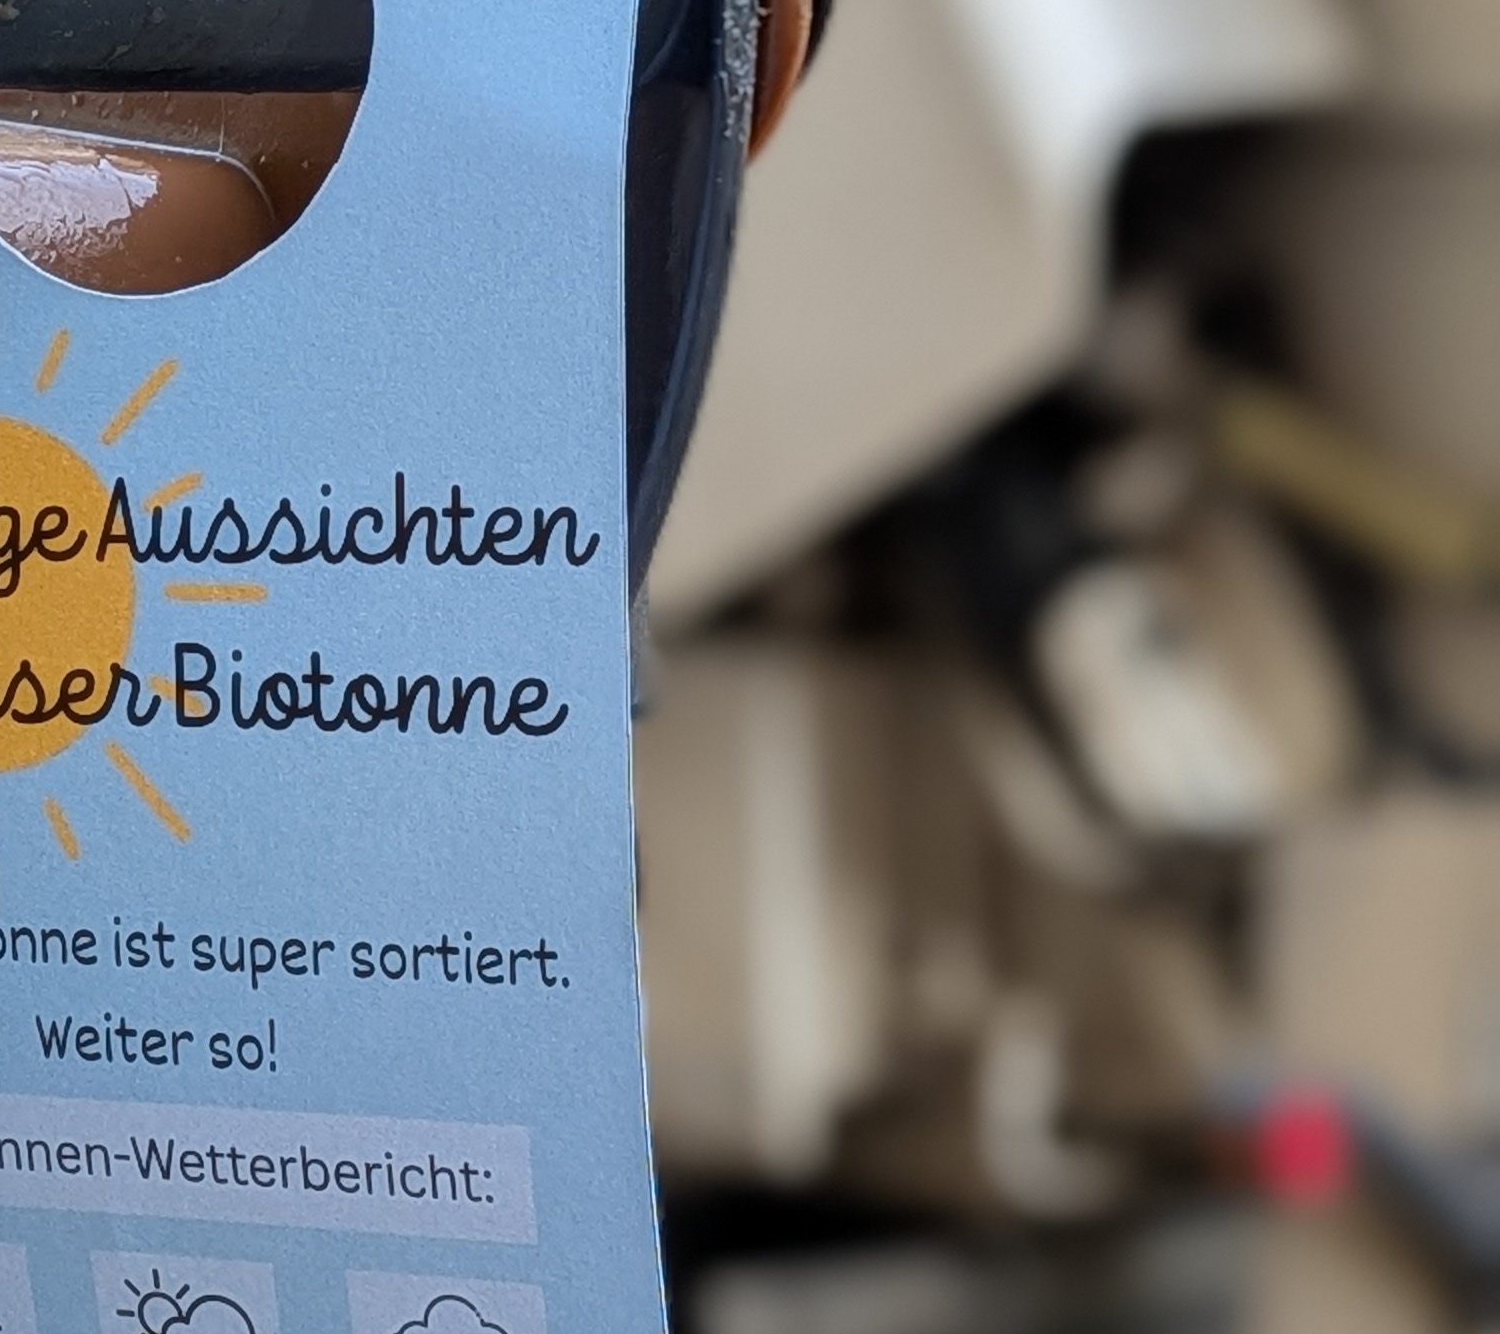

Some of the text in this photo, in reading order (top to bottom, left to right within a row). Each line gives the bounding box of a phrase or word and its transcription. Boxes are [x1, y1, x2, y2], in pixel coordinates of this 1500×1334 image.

[95, 472, 600, 567] Aussichten
[173, 642, 569, 736] Biotonne
[112, 917, 176, 970] ist
[191, 922, 336, 990] super
[350, 932, 571, 989] sortiert.
[36, 1014, 278, 1072] Weiter so!
